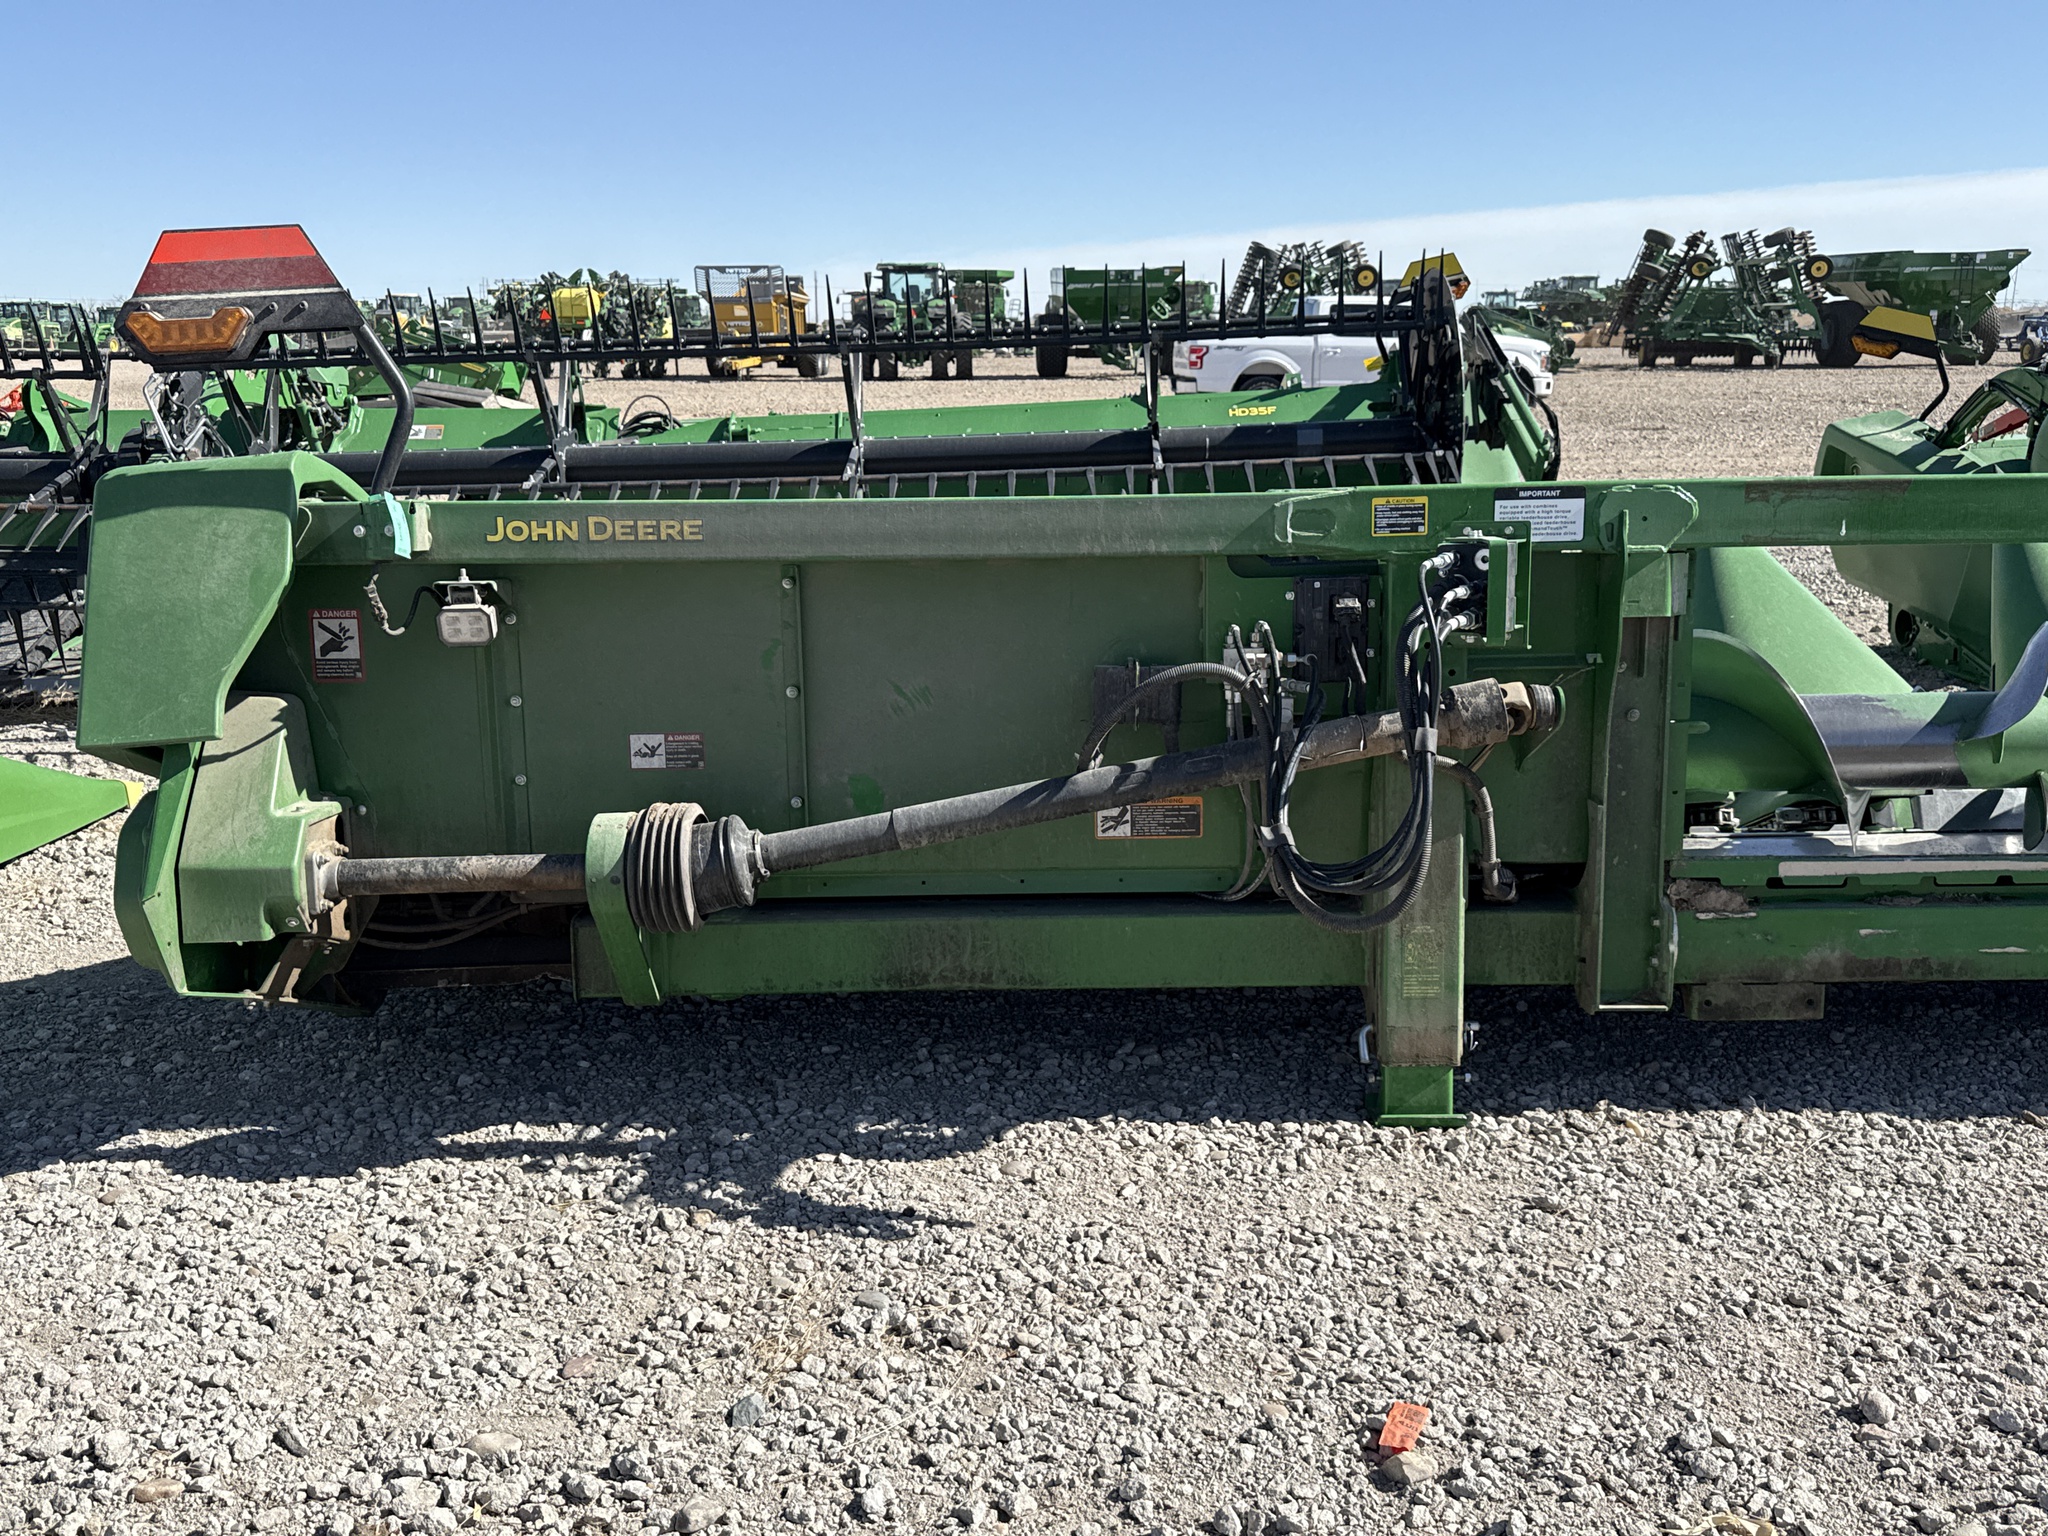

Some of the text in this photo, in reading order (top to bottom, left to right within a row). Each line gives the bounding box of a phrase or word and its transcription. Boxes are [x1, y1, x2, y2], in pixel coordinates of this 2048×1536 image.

[1228, 405, 1277, 417] HD35F
[486, 515, 703, 542] JOHN DEERE
